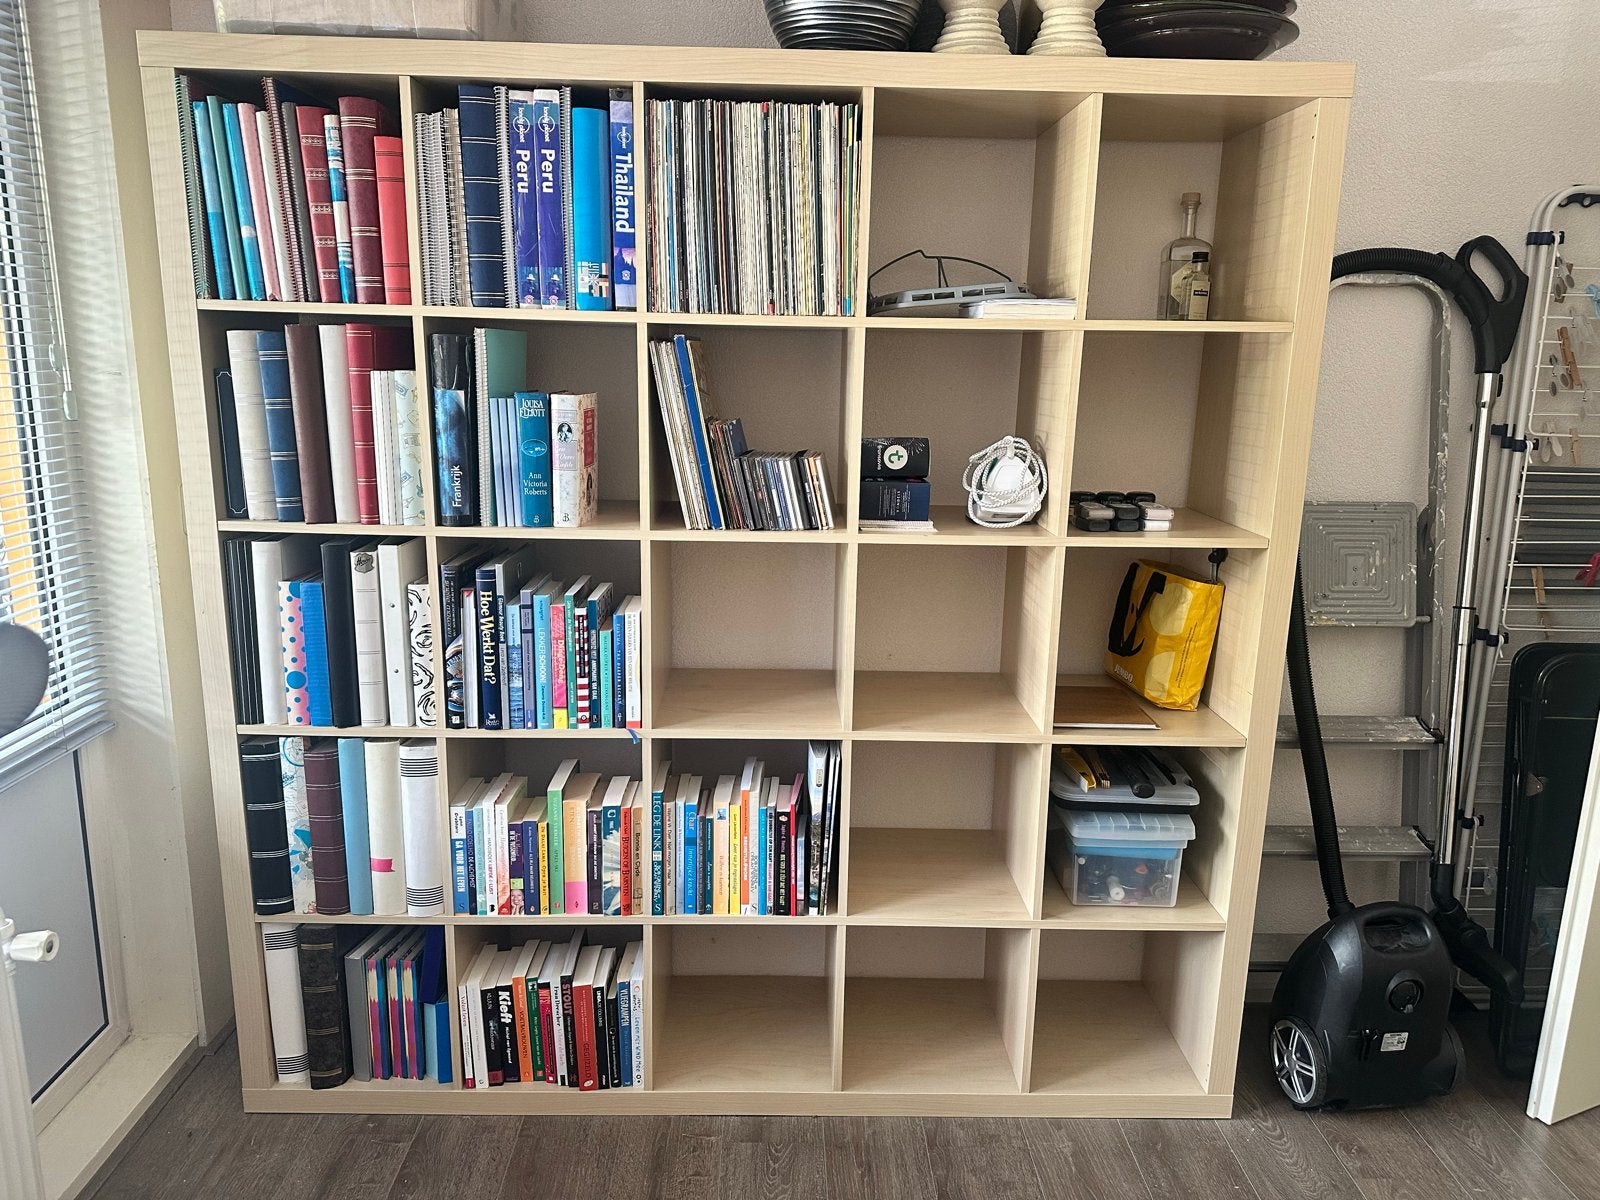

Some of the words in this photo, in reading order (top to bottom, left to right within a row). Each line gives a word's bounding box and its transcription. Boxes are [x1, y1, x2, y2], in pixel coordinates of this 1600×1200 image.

[517, 108, 525, 124] lonely
[542, 106, 550, 124] lonely
[518, 124, 526, 142] planet
[516, 150, 530, 193] Peru
[540, 149, 555, 193] Peru
[615, 153, 635, 232] Thailand
[452, 465, 464, 507] Frankrijk
[523, 480, 548, 488] Victoria
[524, 488, 548, 496] Roberts
[480, 590, 492, 616] Hoe
[480, 616, 495, 654] Werkt
[483, 655, 496, 684] Dat?
[654, 814, 661, 826] DE
[688, 811, 696, 830] Char
[455, 849, 464, 865] VOOR
[636, 852, 640, 860] en
[456, 865, 464, 876] HET
[457, 876, 465, 892] LEVEN
[499, 991, 513, 1024] Kieft
[562, 984, 572, 1015] STOUT
[620, 989, 629, 1027] VLIEGRAMPEN
